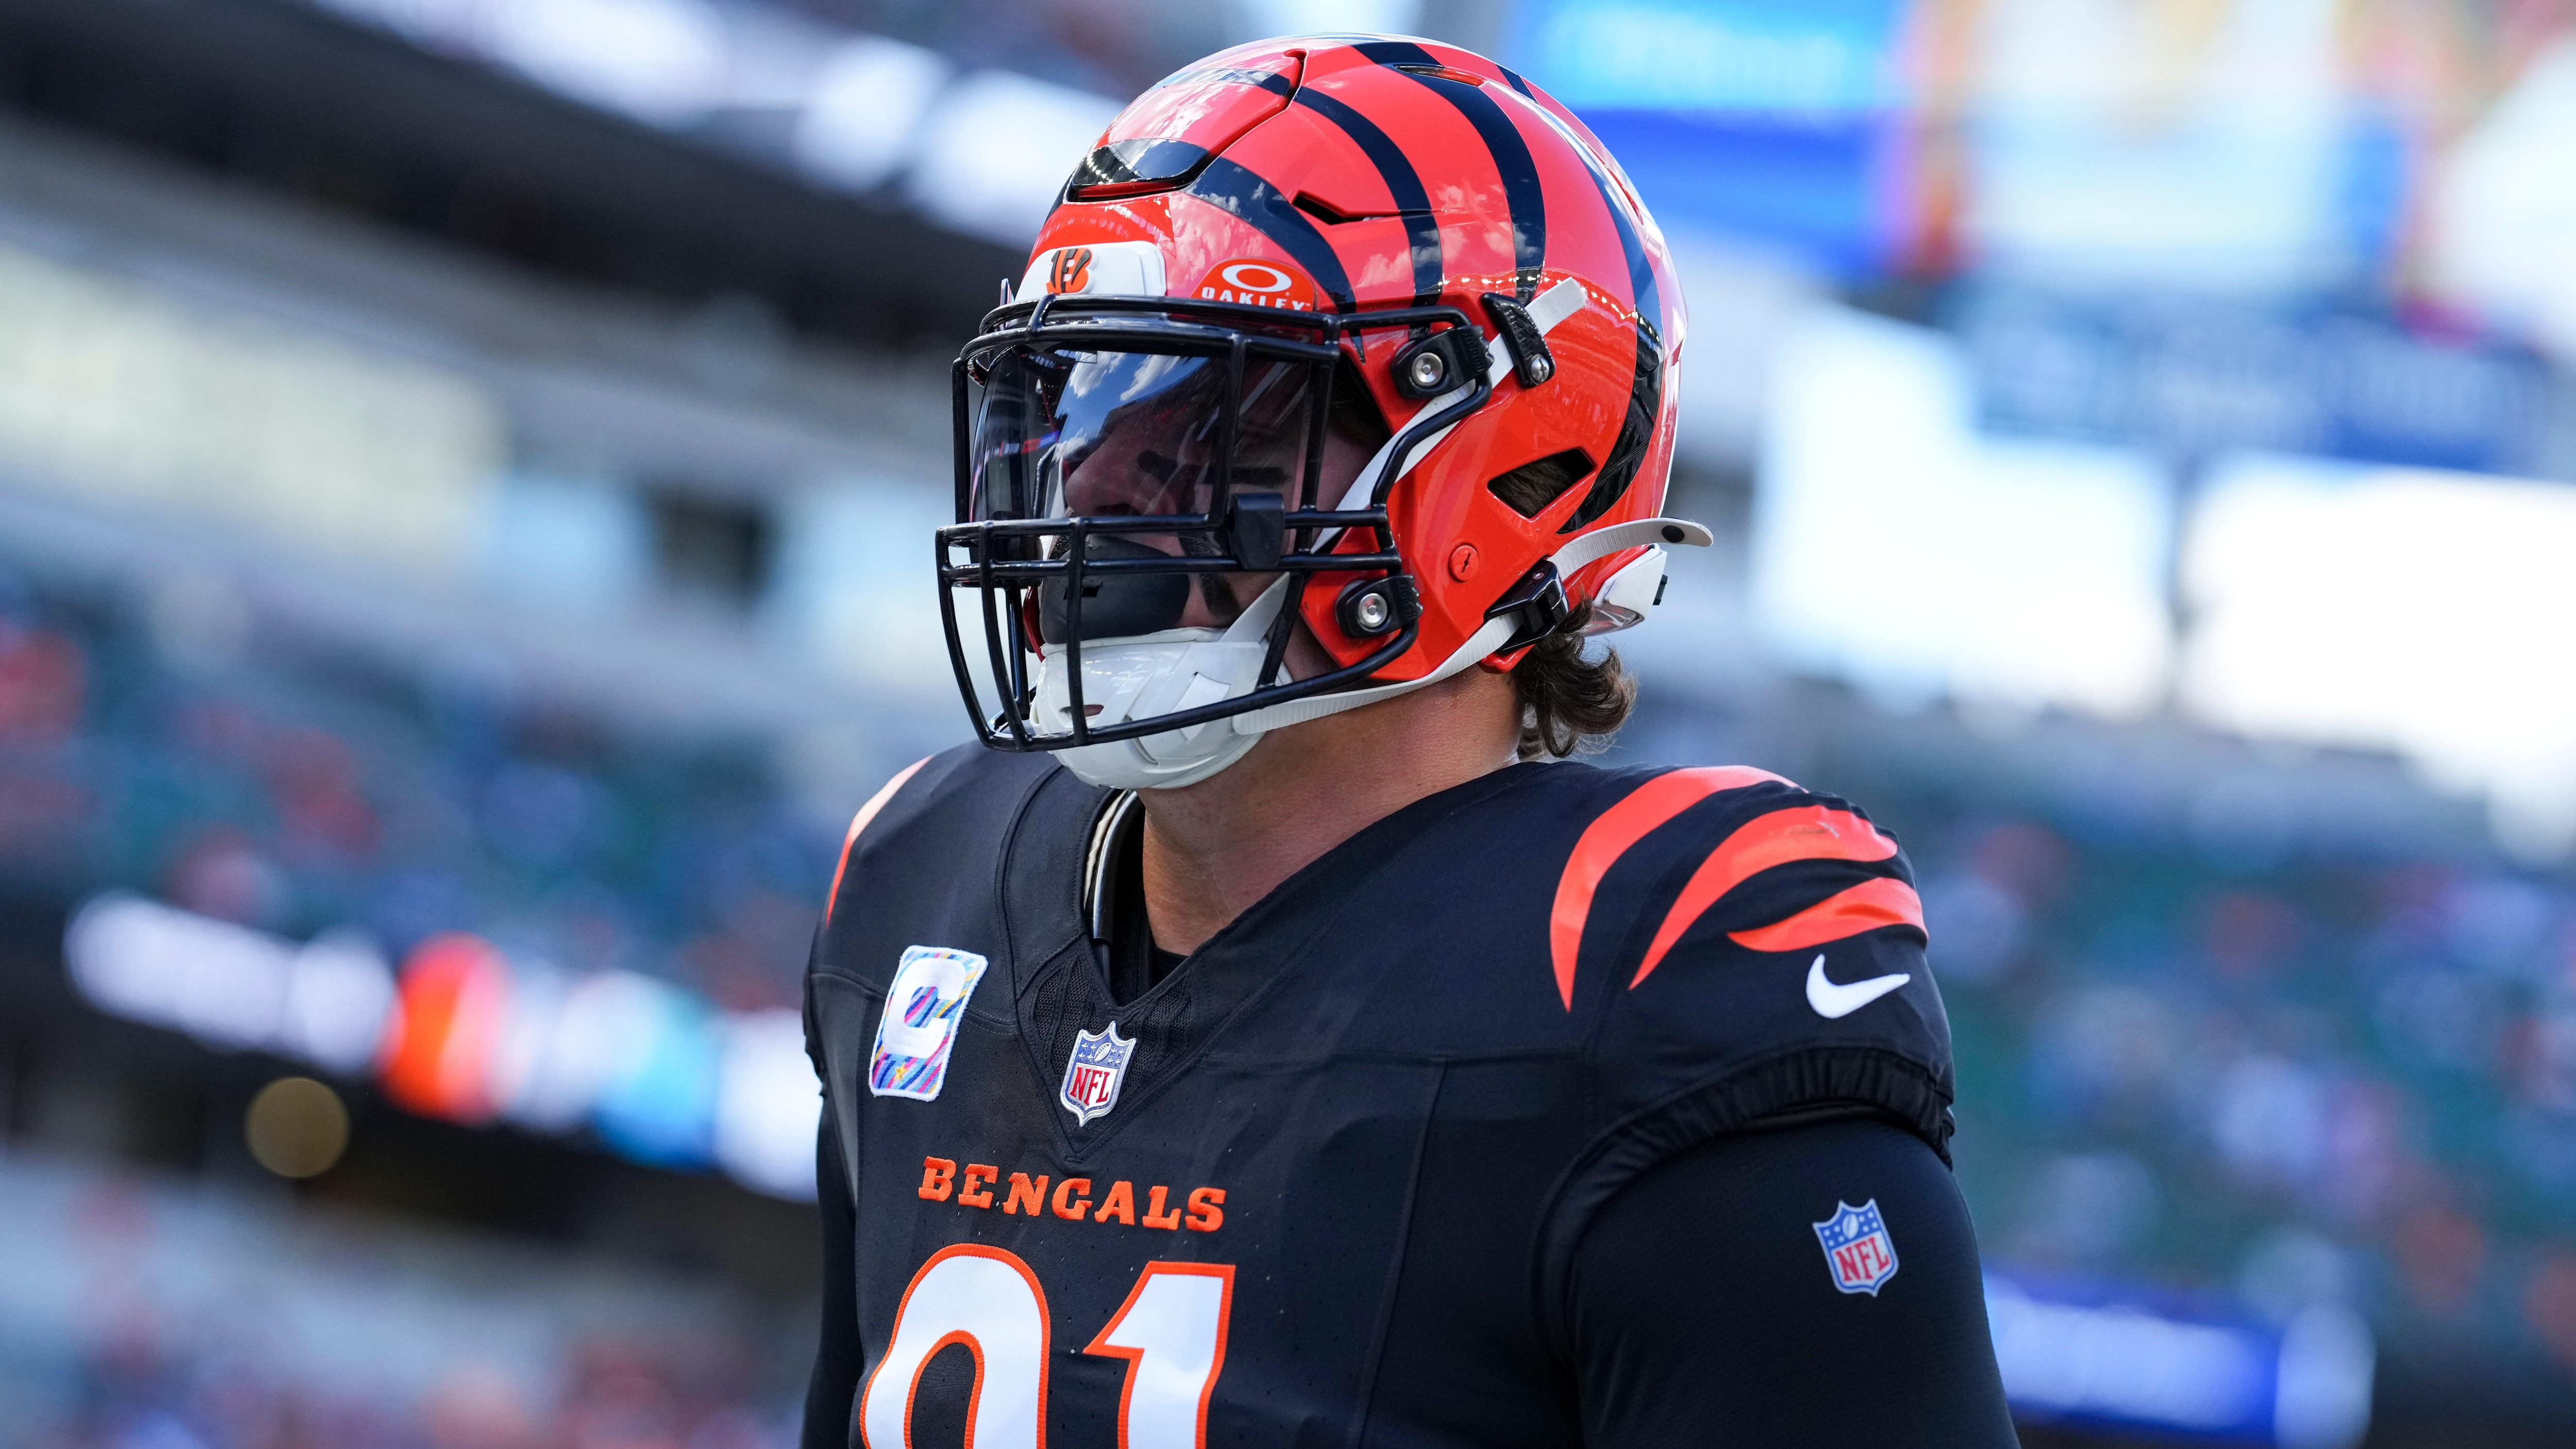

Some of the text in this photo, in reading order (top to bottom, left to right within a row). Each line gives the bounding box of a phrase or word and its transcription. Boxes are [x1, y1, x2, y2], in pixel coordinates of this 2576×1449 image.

[882, 957, 967, 1059] C
[1070, 1067, 1110, 1106] NFL
[918, 1156, 1227, 1232] BENGALS
[1836, 1236, 1890, 1282] NFL
